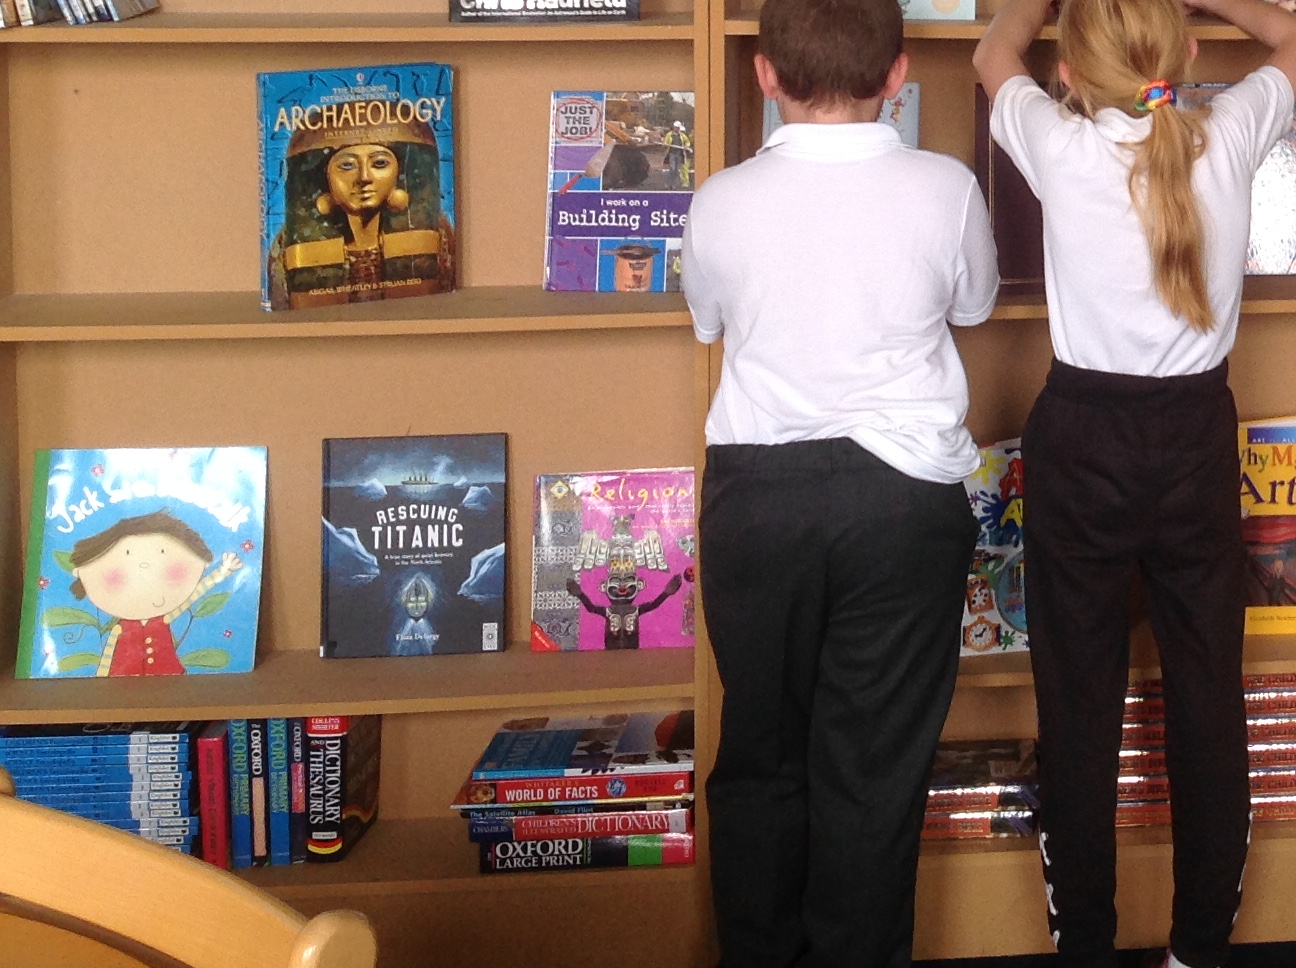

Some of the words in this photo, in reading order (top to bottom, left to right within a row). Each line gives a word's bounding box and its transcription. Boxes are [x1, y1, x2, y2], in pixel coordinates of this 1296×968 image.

[274, 96, 447, 133] ARCHAEOLOGY
[561, 105, 596, 116] JUST
[564, 116, 591, 125] THE
[561, 126, 593, 136] JOB!
[606, 197, 627, 206] work
[558, 209, 640, 230] Building
[650, 210, 688, 226] Site
[591, 478, 689, 511] Religion
[56, 486, 105, 533] Jack
[376, 504, 459, 525] RESCUING
[371, 523, 464, 549] TITANIC
[251, 730, 262, 775] OXFORD
[293, 726, 302, 762] OXFORD
[309, 749, 324, 825] THESAURUS
[324, 739, 342, 823] DICTIONARY
[505, 789, 543, 802] WORLD
[549, 788, 562, 800] OF
[566, 786, 599, 799] FACTS
[517, 808, 535, 816] Atlas
[473, 825, 509, 834] CHAMBERS
[578, 815, 671, 832] DICTIONARY
[495, 838, 583, 857] OXFORD
[496, 857, 538, 869] LARGE
[541, 854, 583, 867] PRINT
